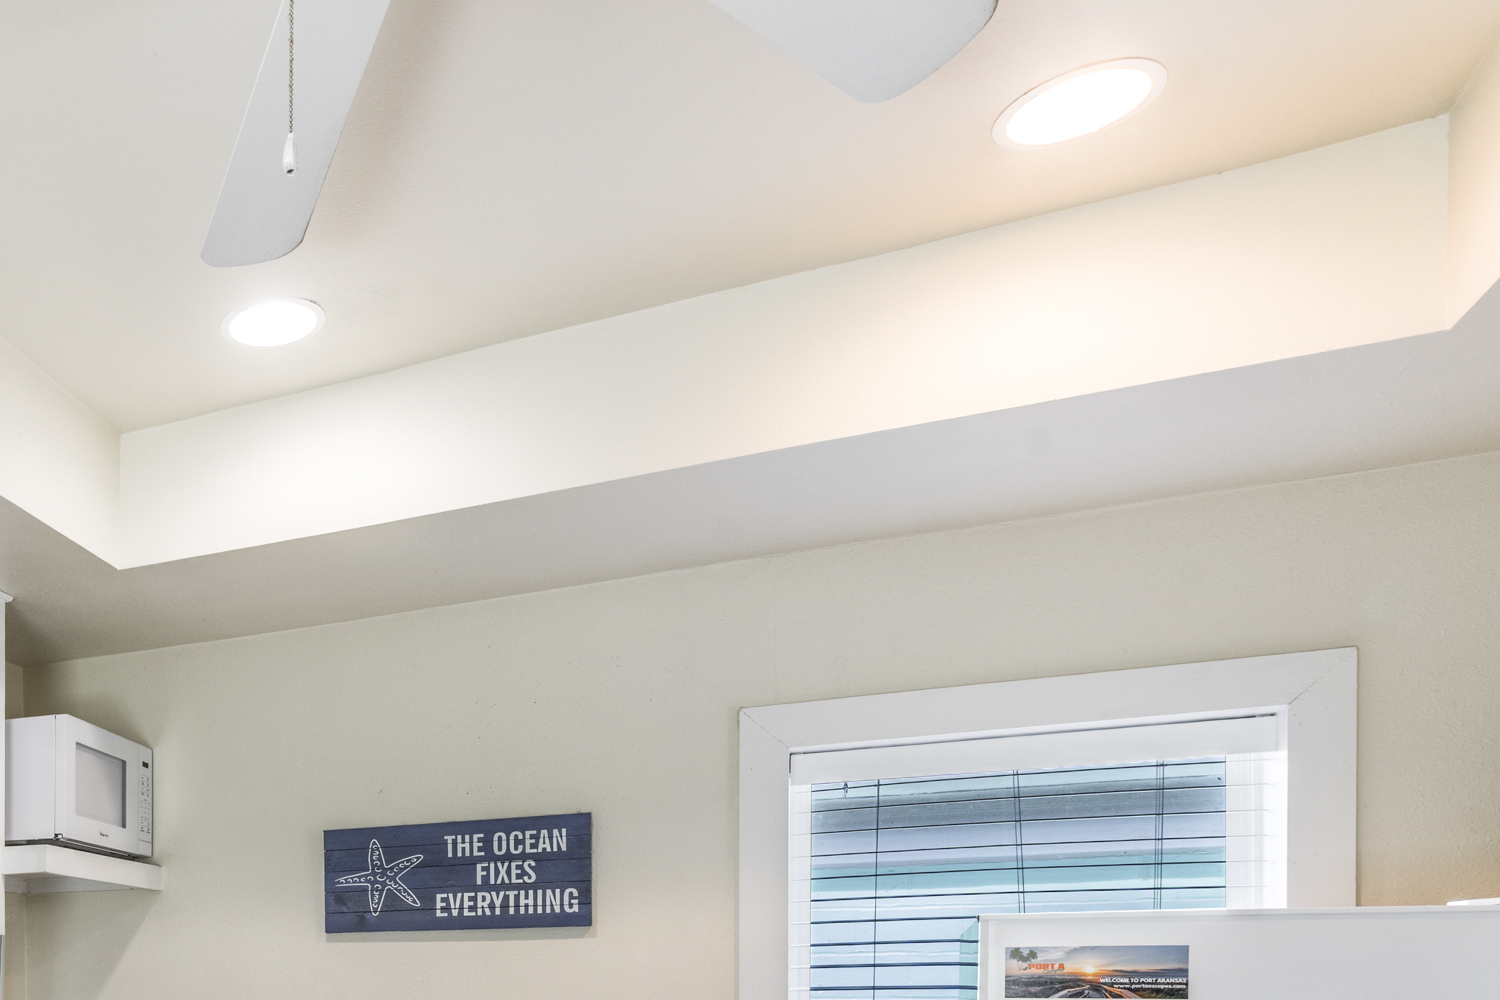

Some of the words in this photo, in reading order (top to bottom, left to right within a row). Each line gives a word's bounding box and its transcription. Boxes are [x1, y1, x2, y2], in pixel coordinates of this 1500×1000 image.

[444, 833, 485, 858] THE
[492, 828, 567, 855] OCEAN
[476, 859, 537, 885] FIXES
[435, 887, 579, 917] EVERYTHING
